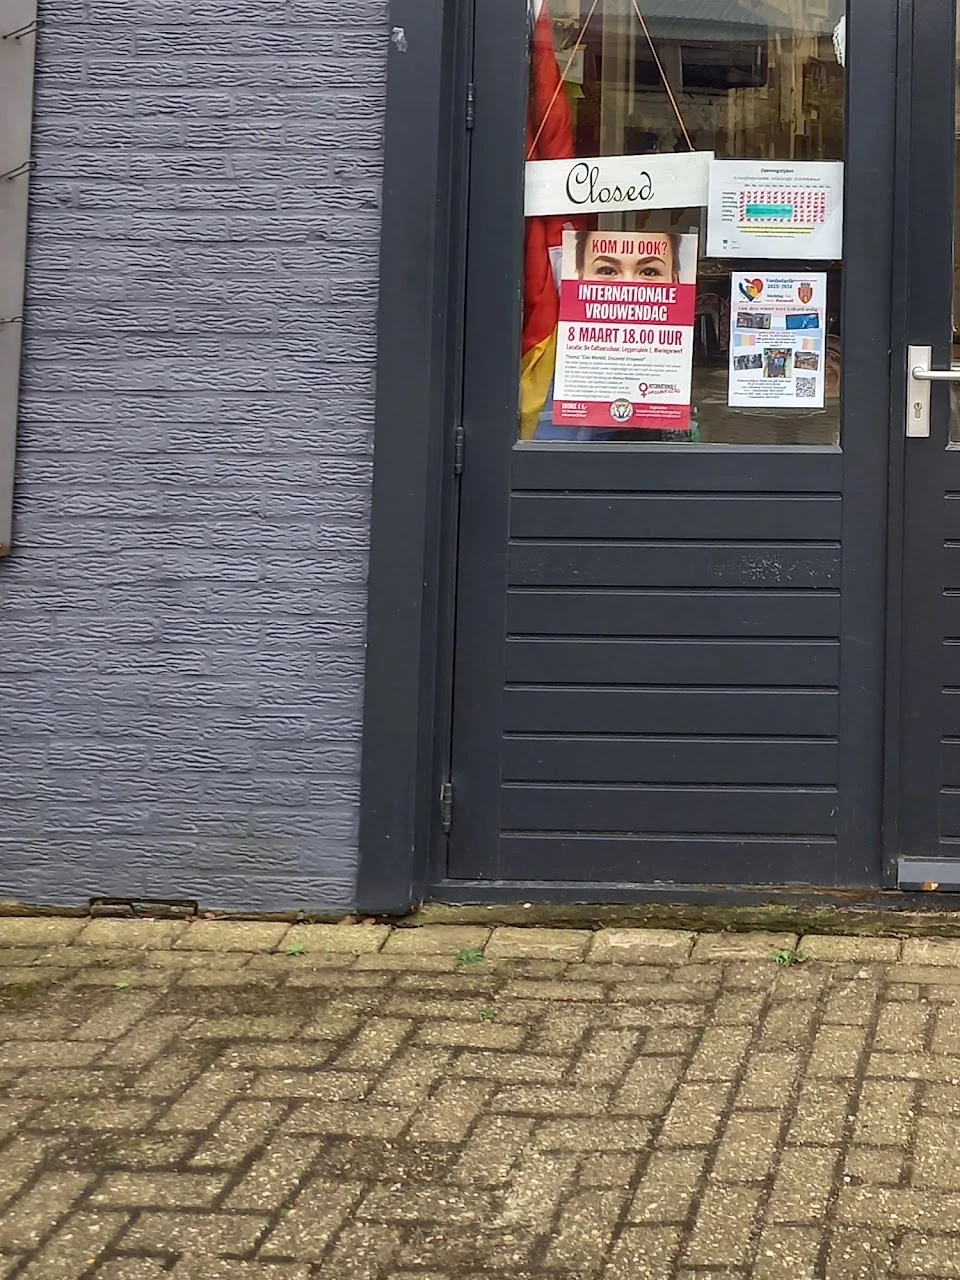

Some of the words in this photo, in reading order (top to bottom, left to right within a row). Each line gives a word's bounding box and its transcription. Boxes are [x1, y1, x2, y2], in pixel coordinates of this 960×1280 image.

[565, 162, 655, 205] Closed
[592, 239, 617, 254] KOM
[620, 240, 634, 255] JIJ
[638, 240, 668, 255] OOK?
[578, 284, 677, 303] INTERNATIONALE
[585, 302, 668, 321] VROUWENDAG
[568, 326, 575, 342] 8
[579, 327, 620, 343] MAART
[622, 328, 655, 344] 18.00
[659, 330, 683, 346] UUR
